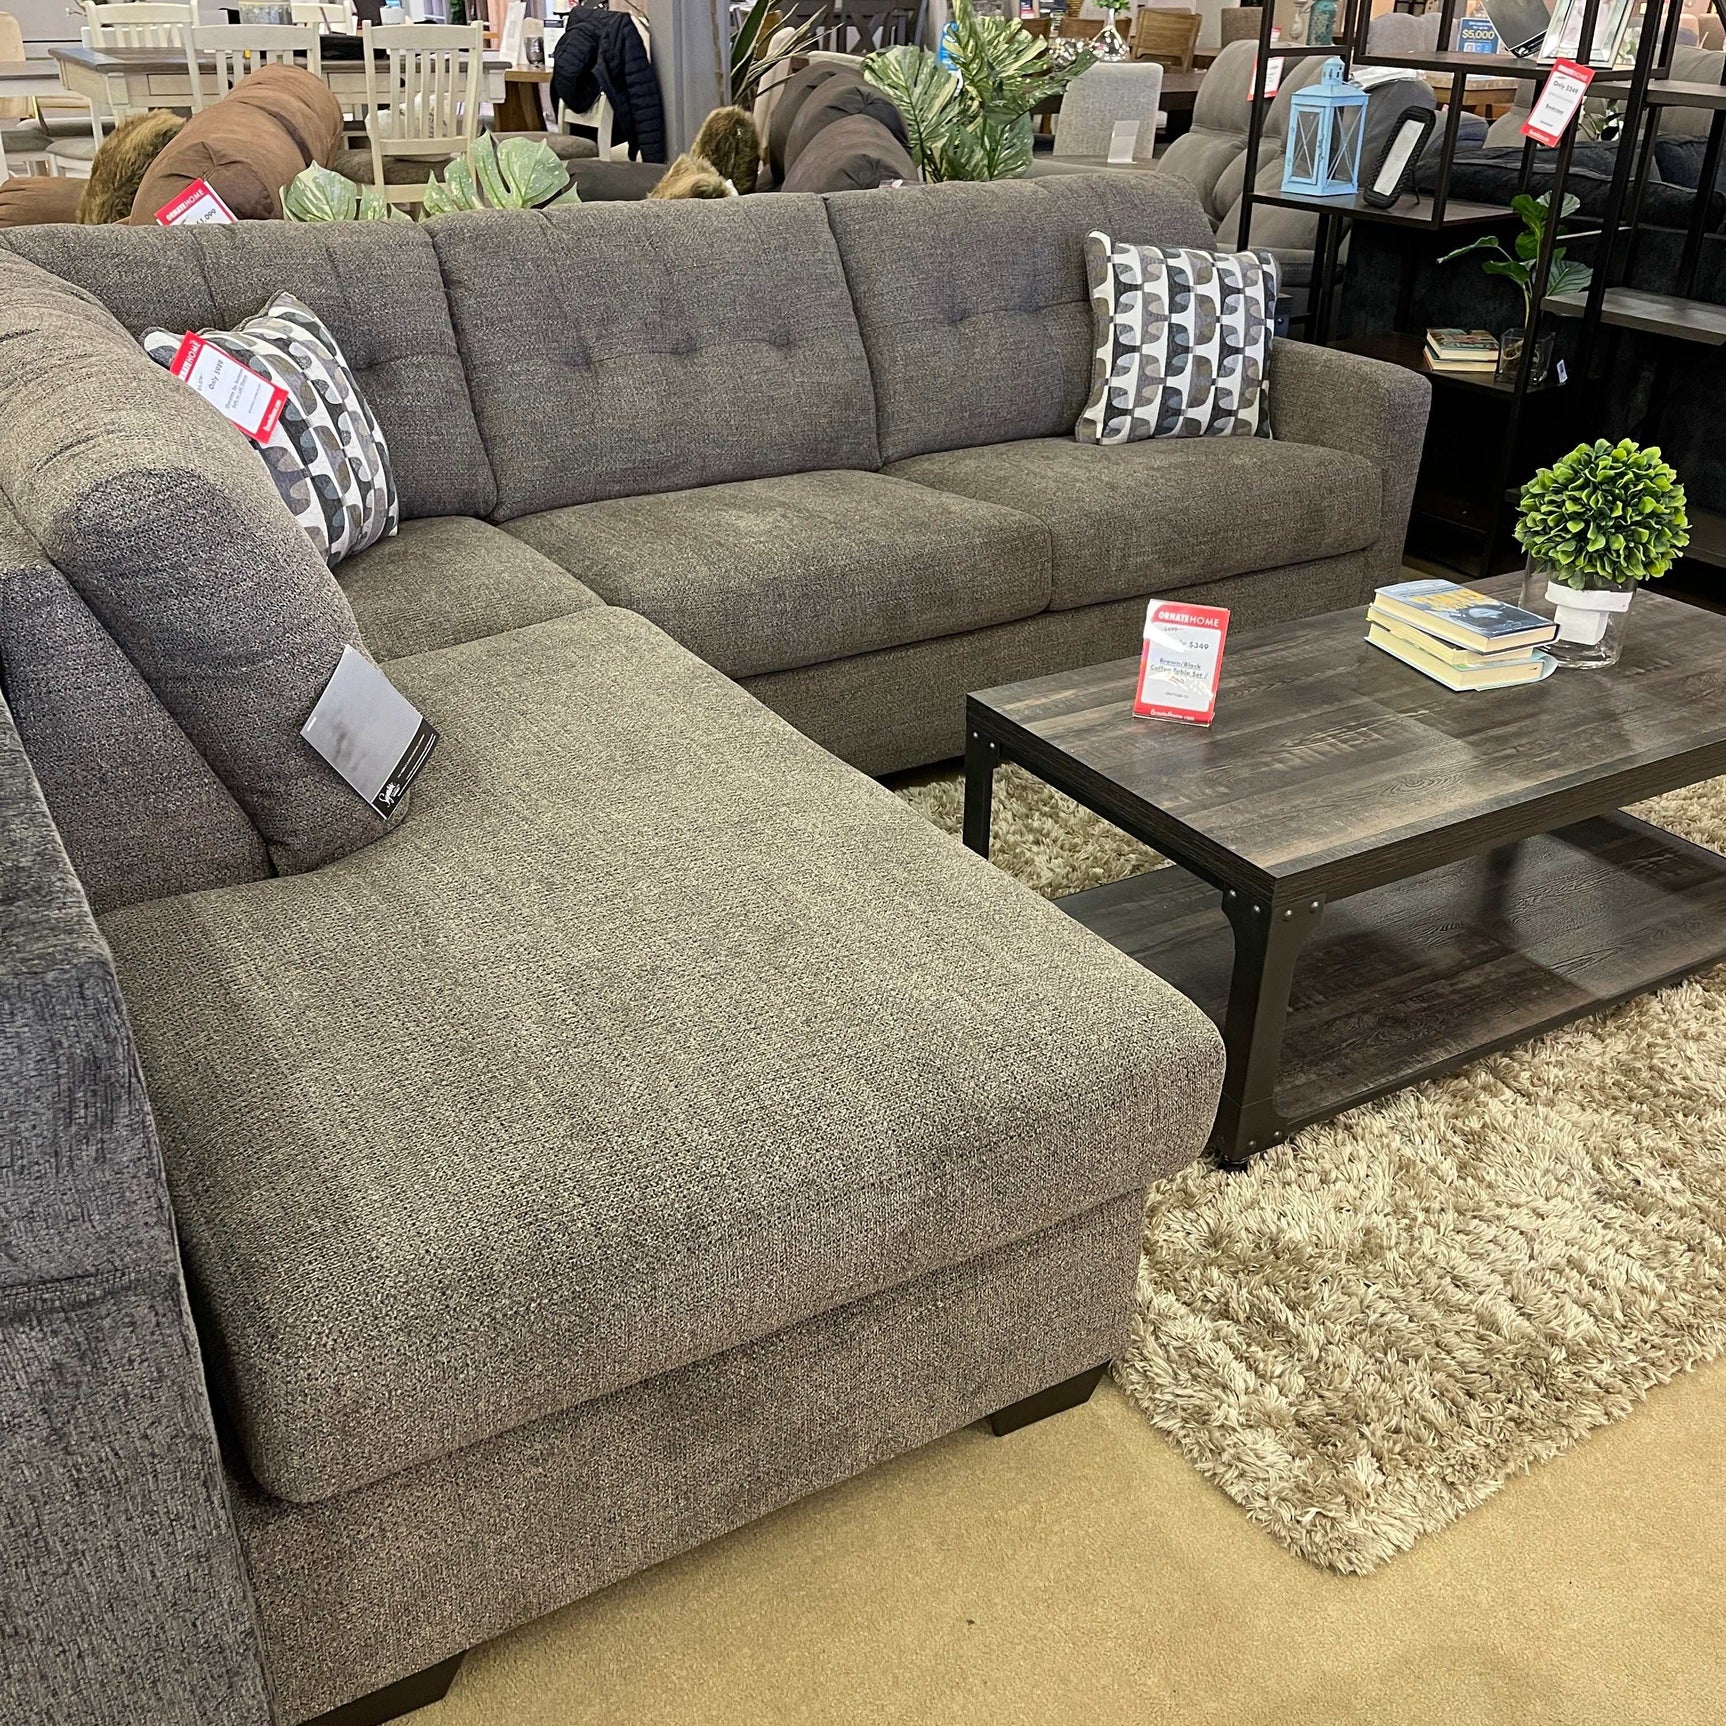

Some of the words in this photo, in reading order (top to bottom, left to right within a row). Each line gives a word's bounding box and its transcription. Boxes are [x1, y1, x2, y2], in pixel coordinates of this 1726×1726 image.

[1462, 29, 1495, 40] $5,000
[165, 188, 205, 222] ORNATEHOME
[208, 376, 220, 390] Only
[1158, 611, 1220, 627] ORNATEHOME
[1188, 641, 1209, 650] $349
[1160, 658, 1201, 669] Brown/Black
[1173, 668, 1190, 676] Table
[1192, 670, 1203, 678] Set
